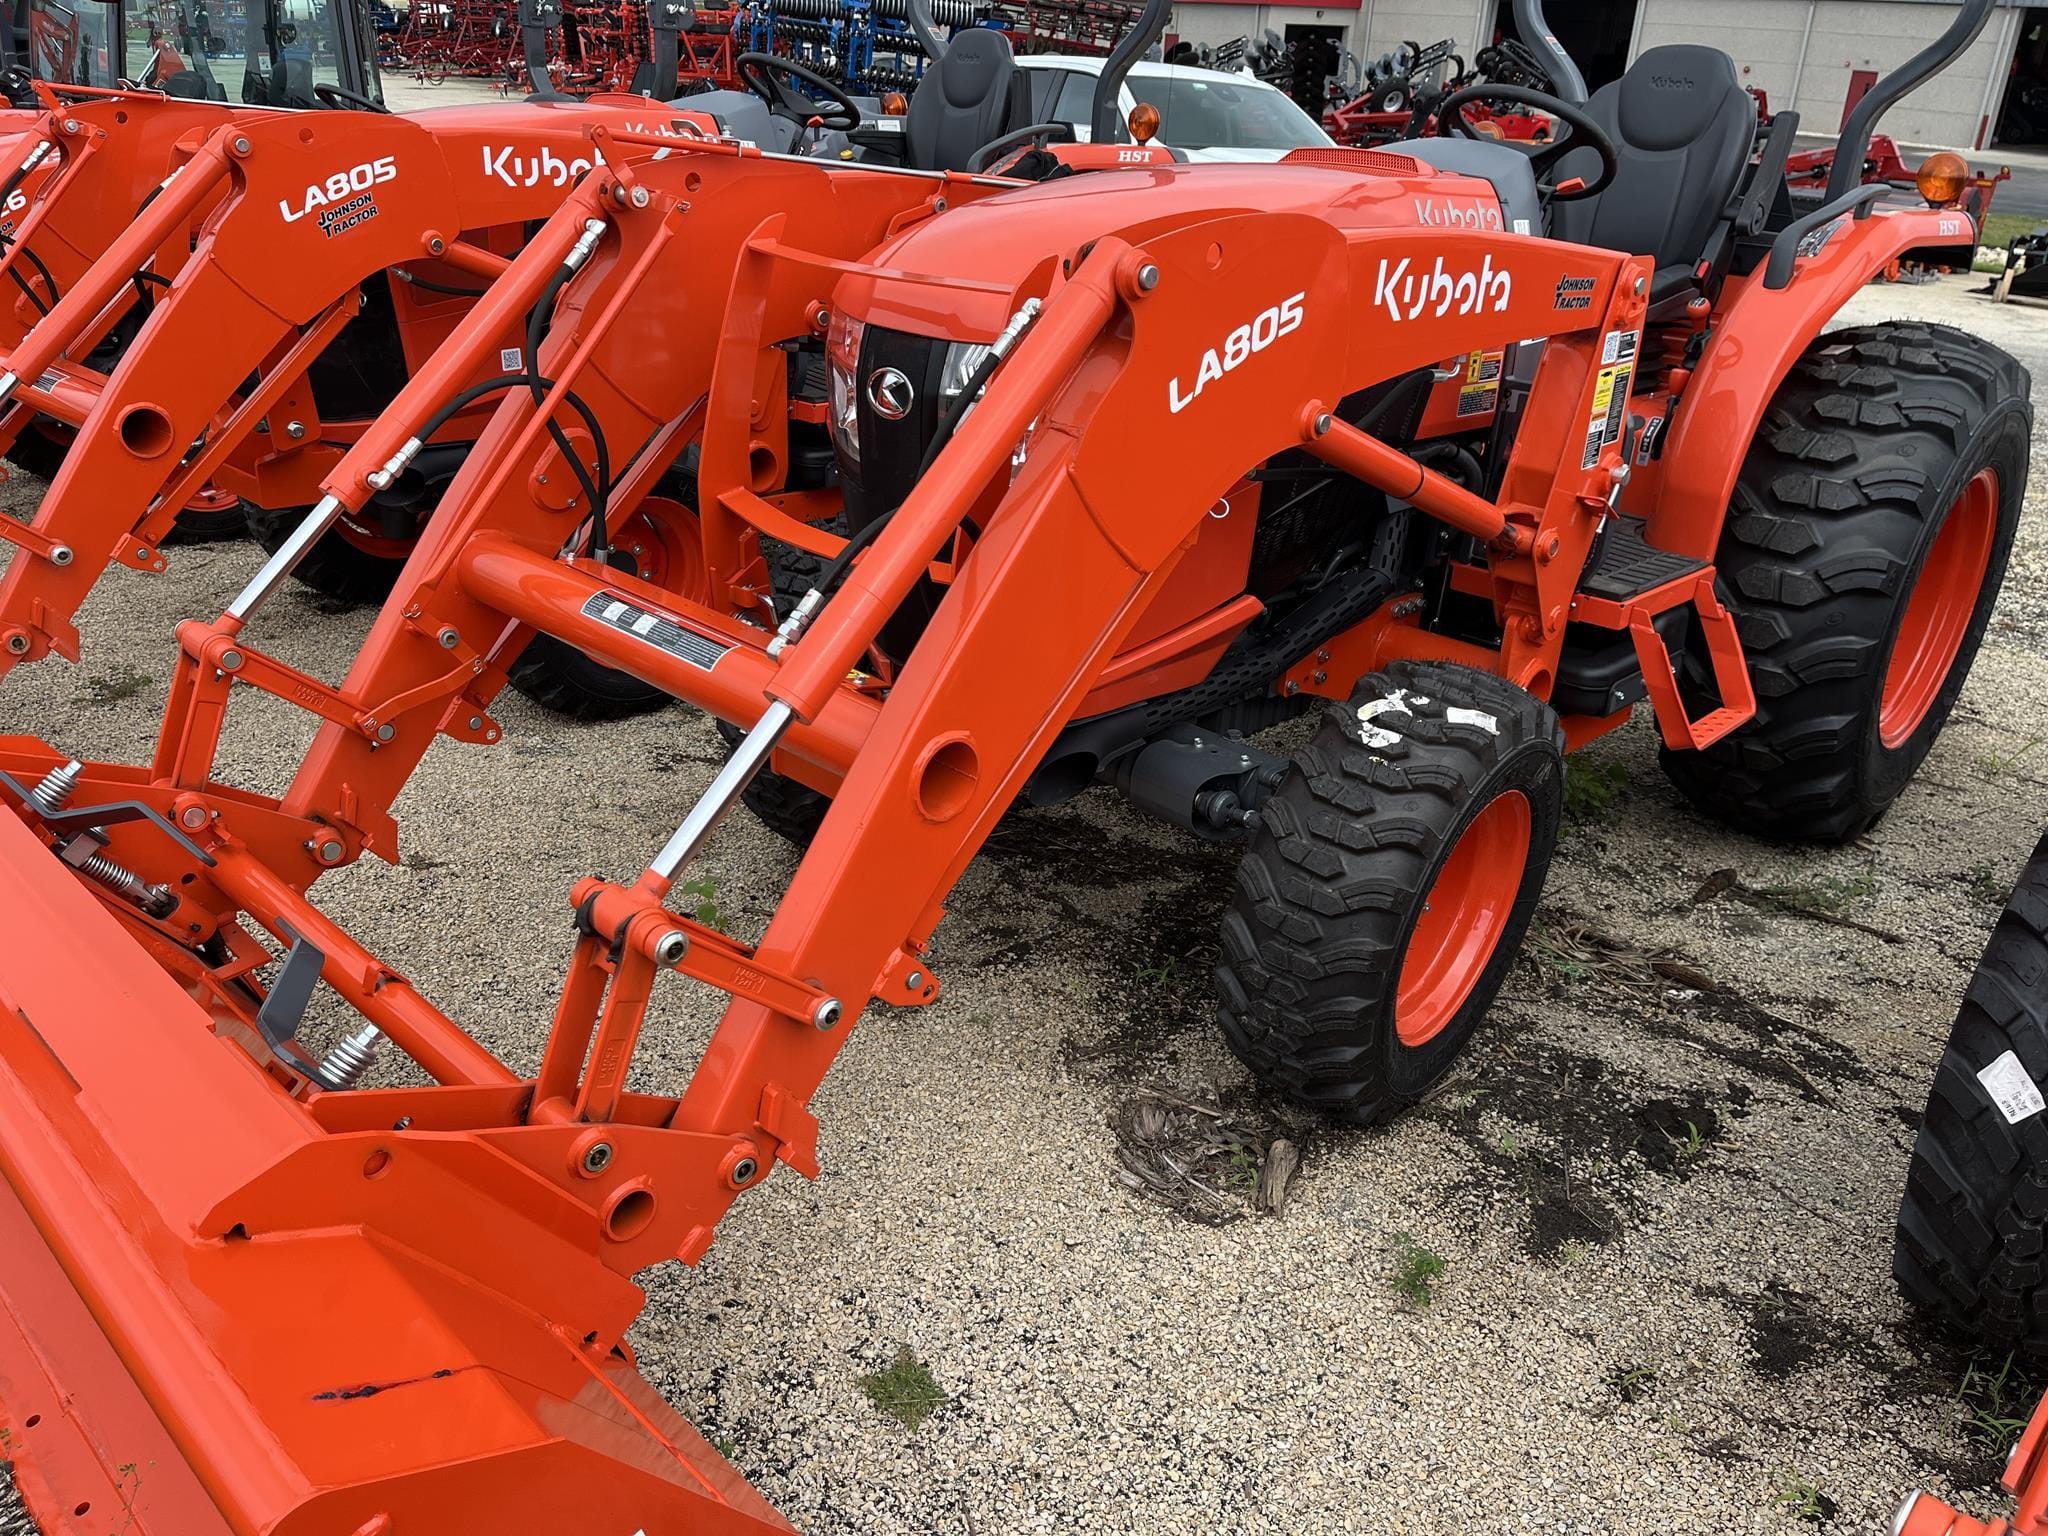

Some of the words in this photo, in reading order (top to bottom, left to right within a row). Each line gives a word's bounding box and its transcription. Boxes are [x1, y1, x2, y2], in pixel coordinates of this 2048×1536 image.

[1651, 76, 1695, 90] Kubota
[1118, 150, 1152, 162] HST
[279, 155, 397, 223] LA805
[1414, 199, 1501, 231] Kubota
[1938, 220, 1960, 236] HST
[1374, 254, 1511, 322] Kubota
[1169, 291, 1306, 414] LA805
